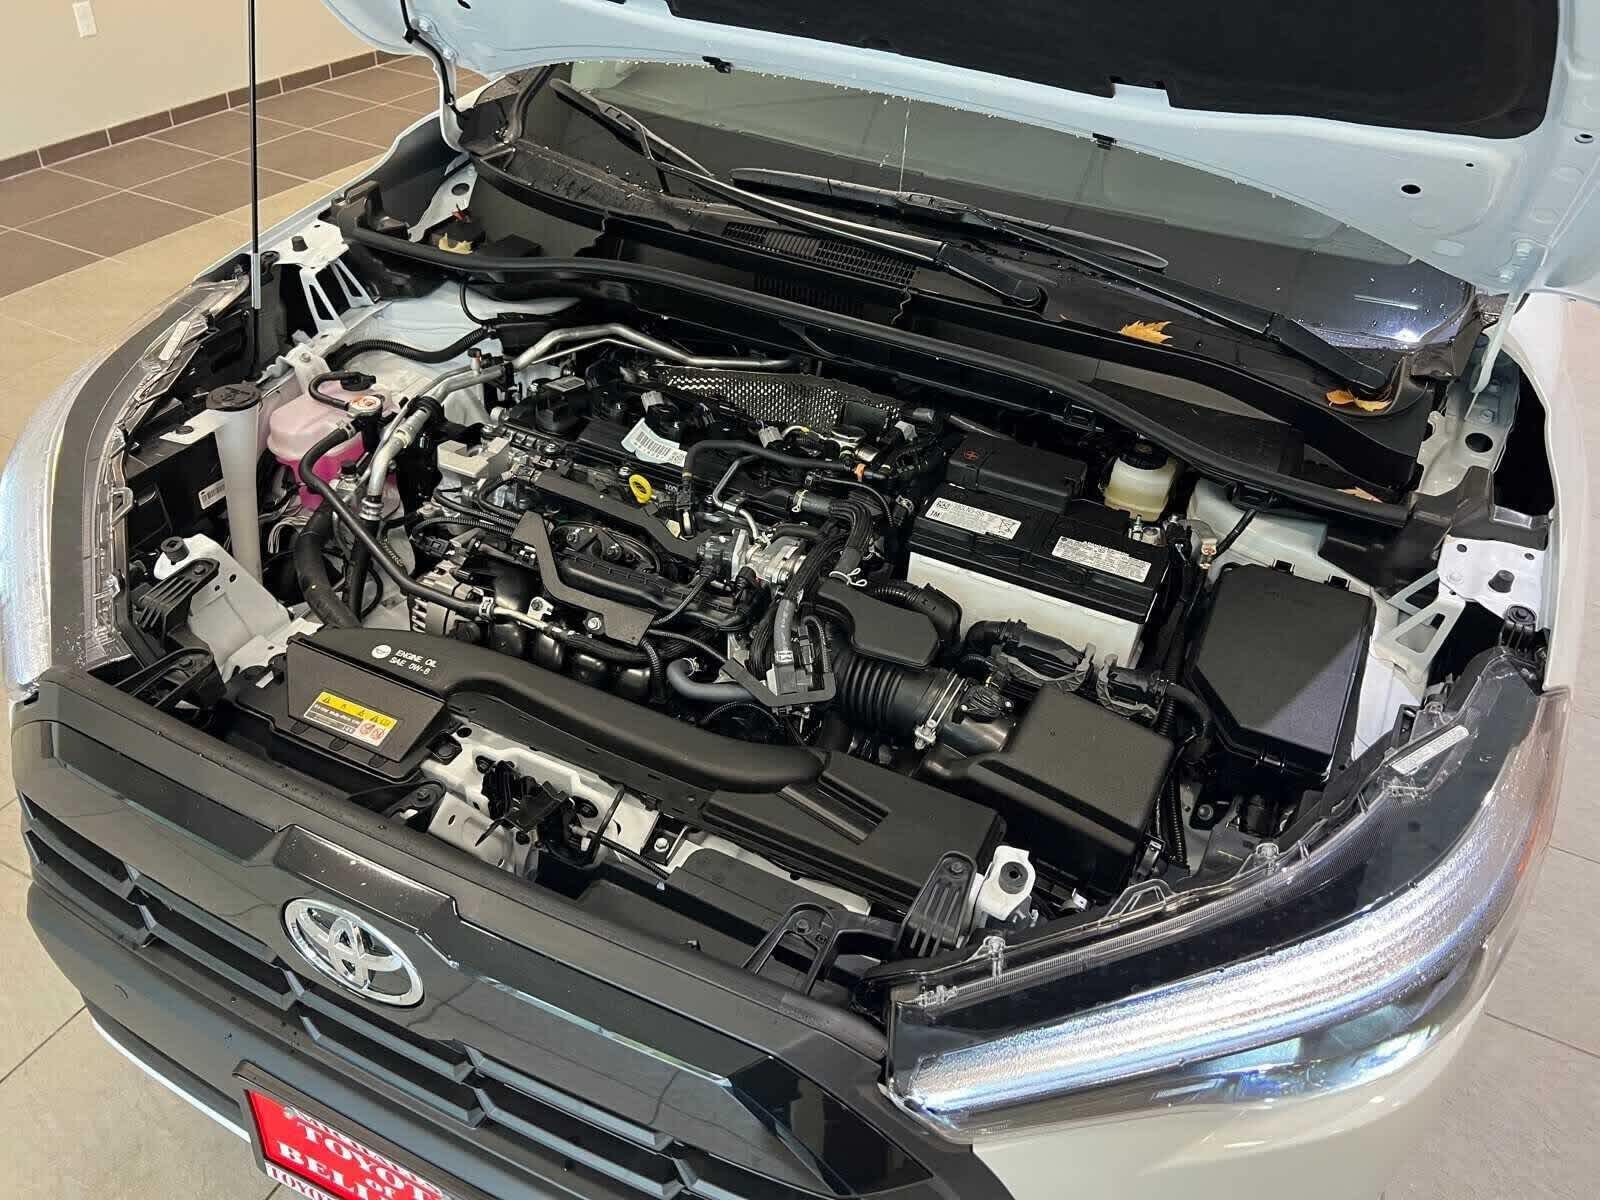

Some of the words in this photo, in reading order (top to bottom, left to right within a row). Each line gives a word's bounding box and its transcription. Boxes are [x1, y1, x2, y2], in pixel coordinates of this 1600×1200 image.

[389, 656, 407, 667] SAE
[395, 649, 423, 663] ENGINE
[424, 658, 437, 668] OIL
[296, 1121, 433, 1200] TOYOT
